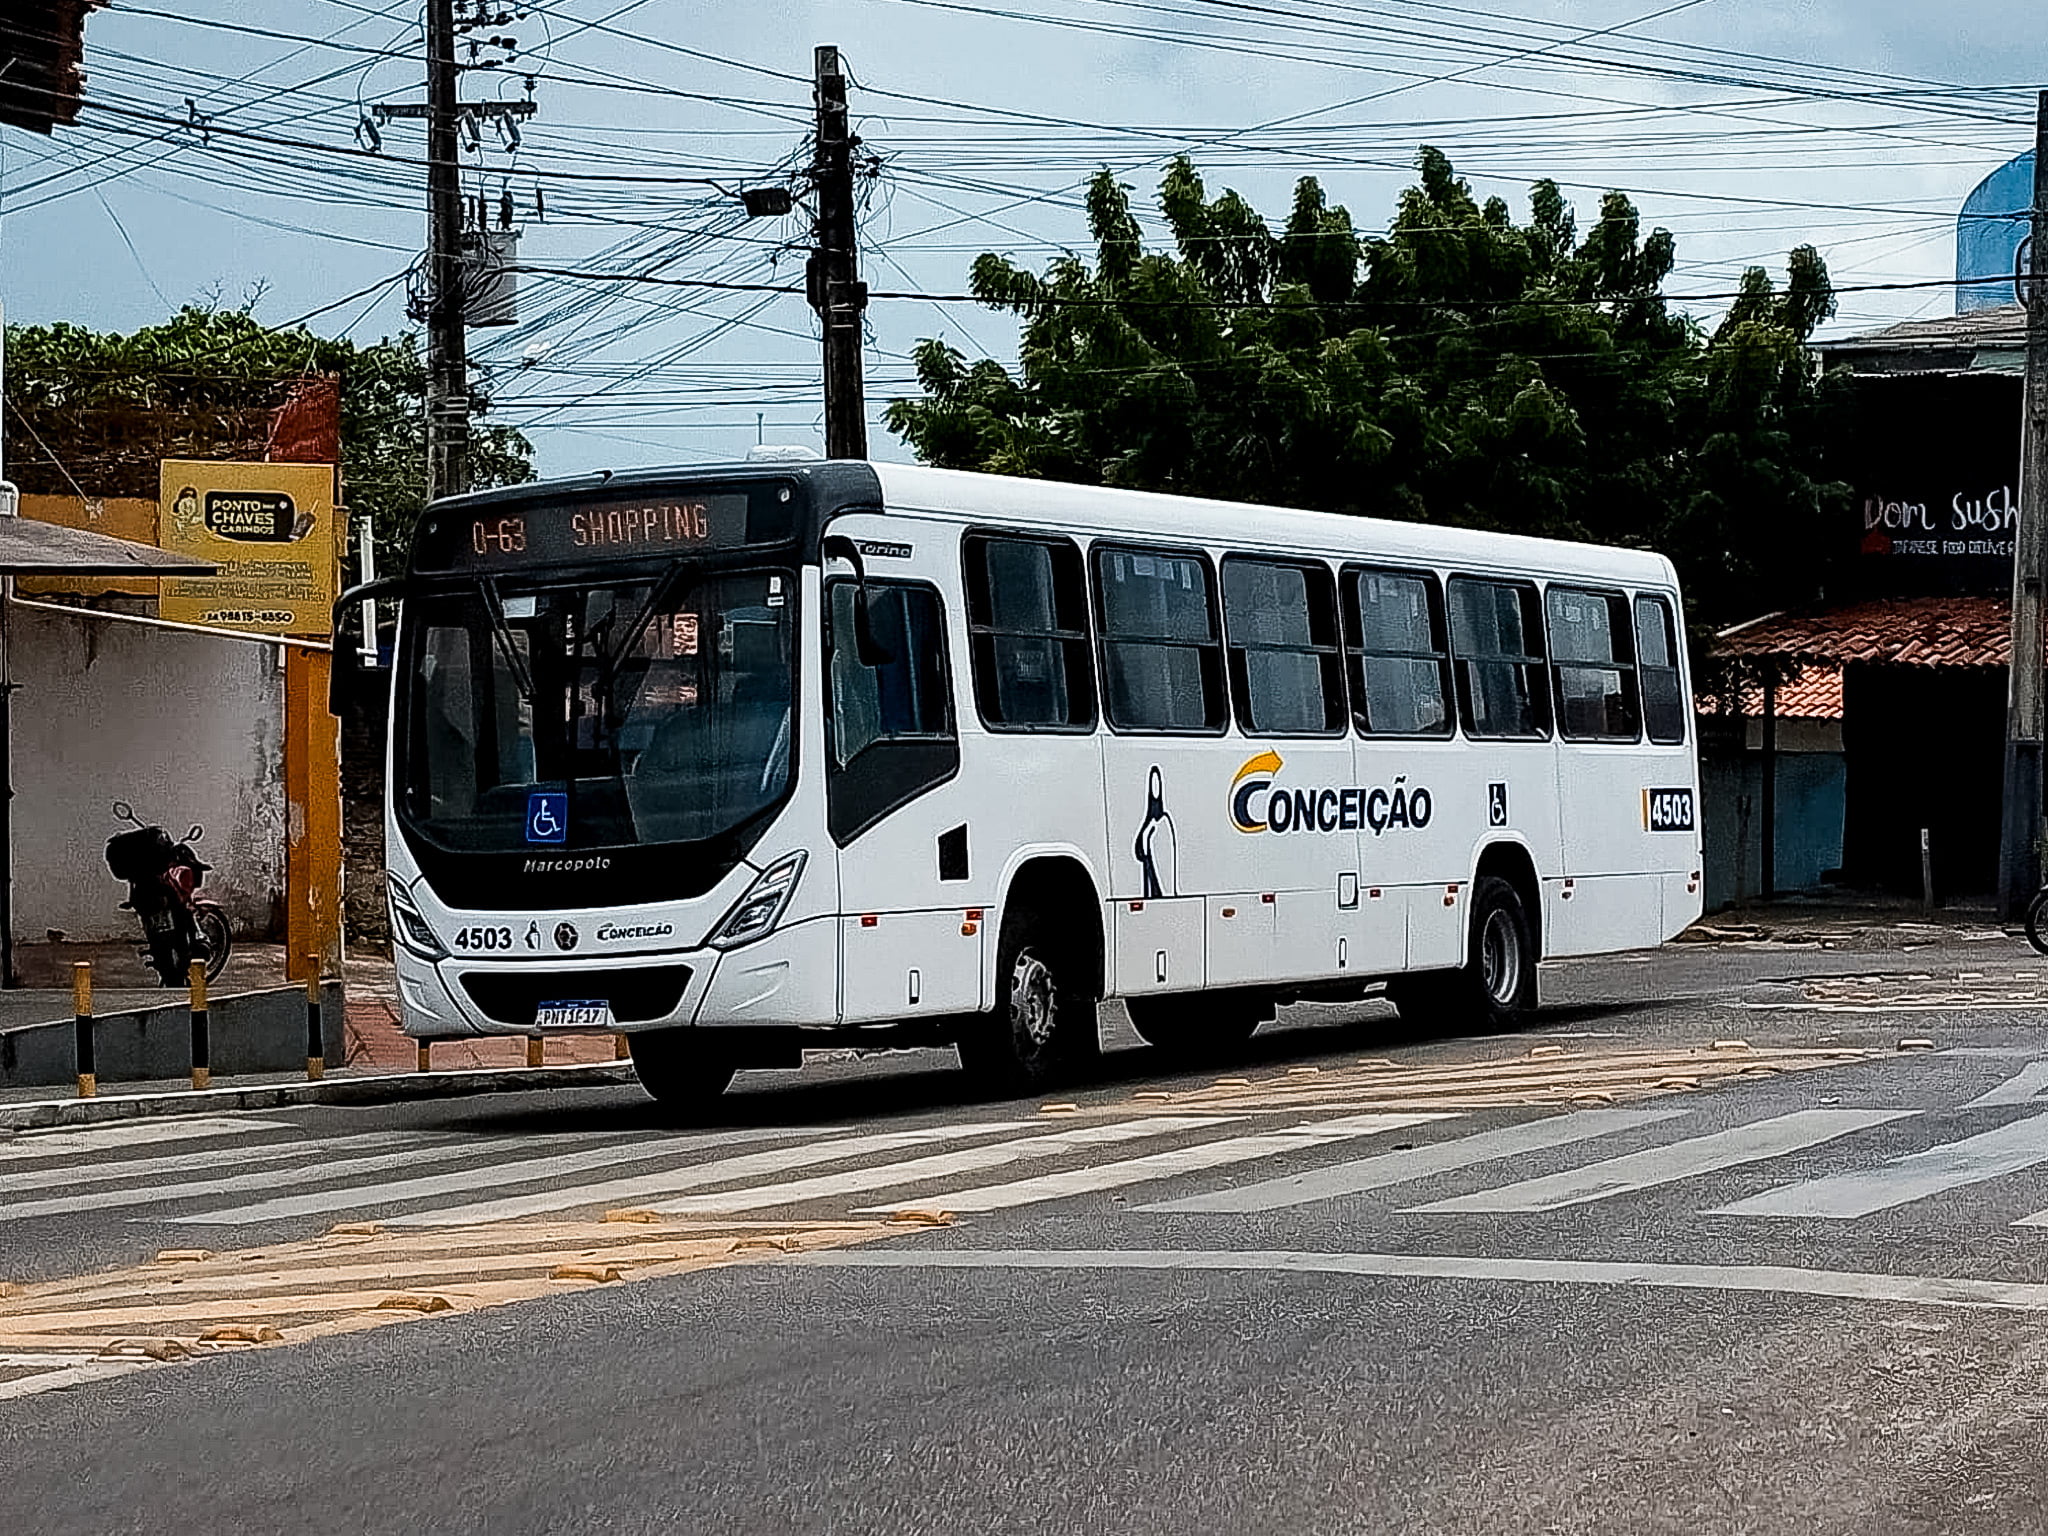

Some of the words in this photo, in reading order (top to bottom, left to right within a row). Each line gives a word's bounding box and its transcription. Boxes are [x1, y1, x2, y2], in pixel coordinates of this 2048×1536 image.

[212, 499, 261, 512] PONTO
[212, 511, 275, 525] CHAVES
[1864, 496, 1935, 530] Dom
[1952, 485, 2019, 531] Sush
[571, 504, 707, 547] SHOPPING
[1233, 775, 1432, 836] CONCEIÇÃO
[1652, 794, 1691, 826] 4503
[523, 856, 611, 873] Marcopolo
[455, 927, 512, 950] 4503
